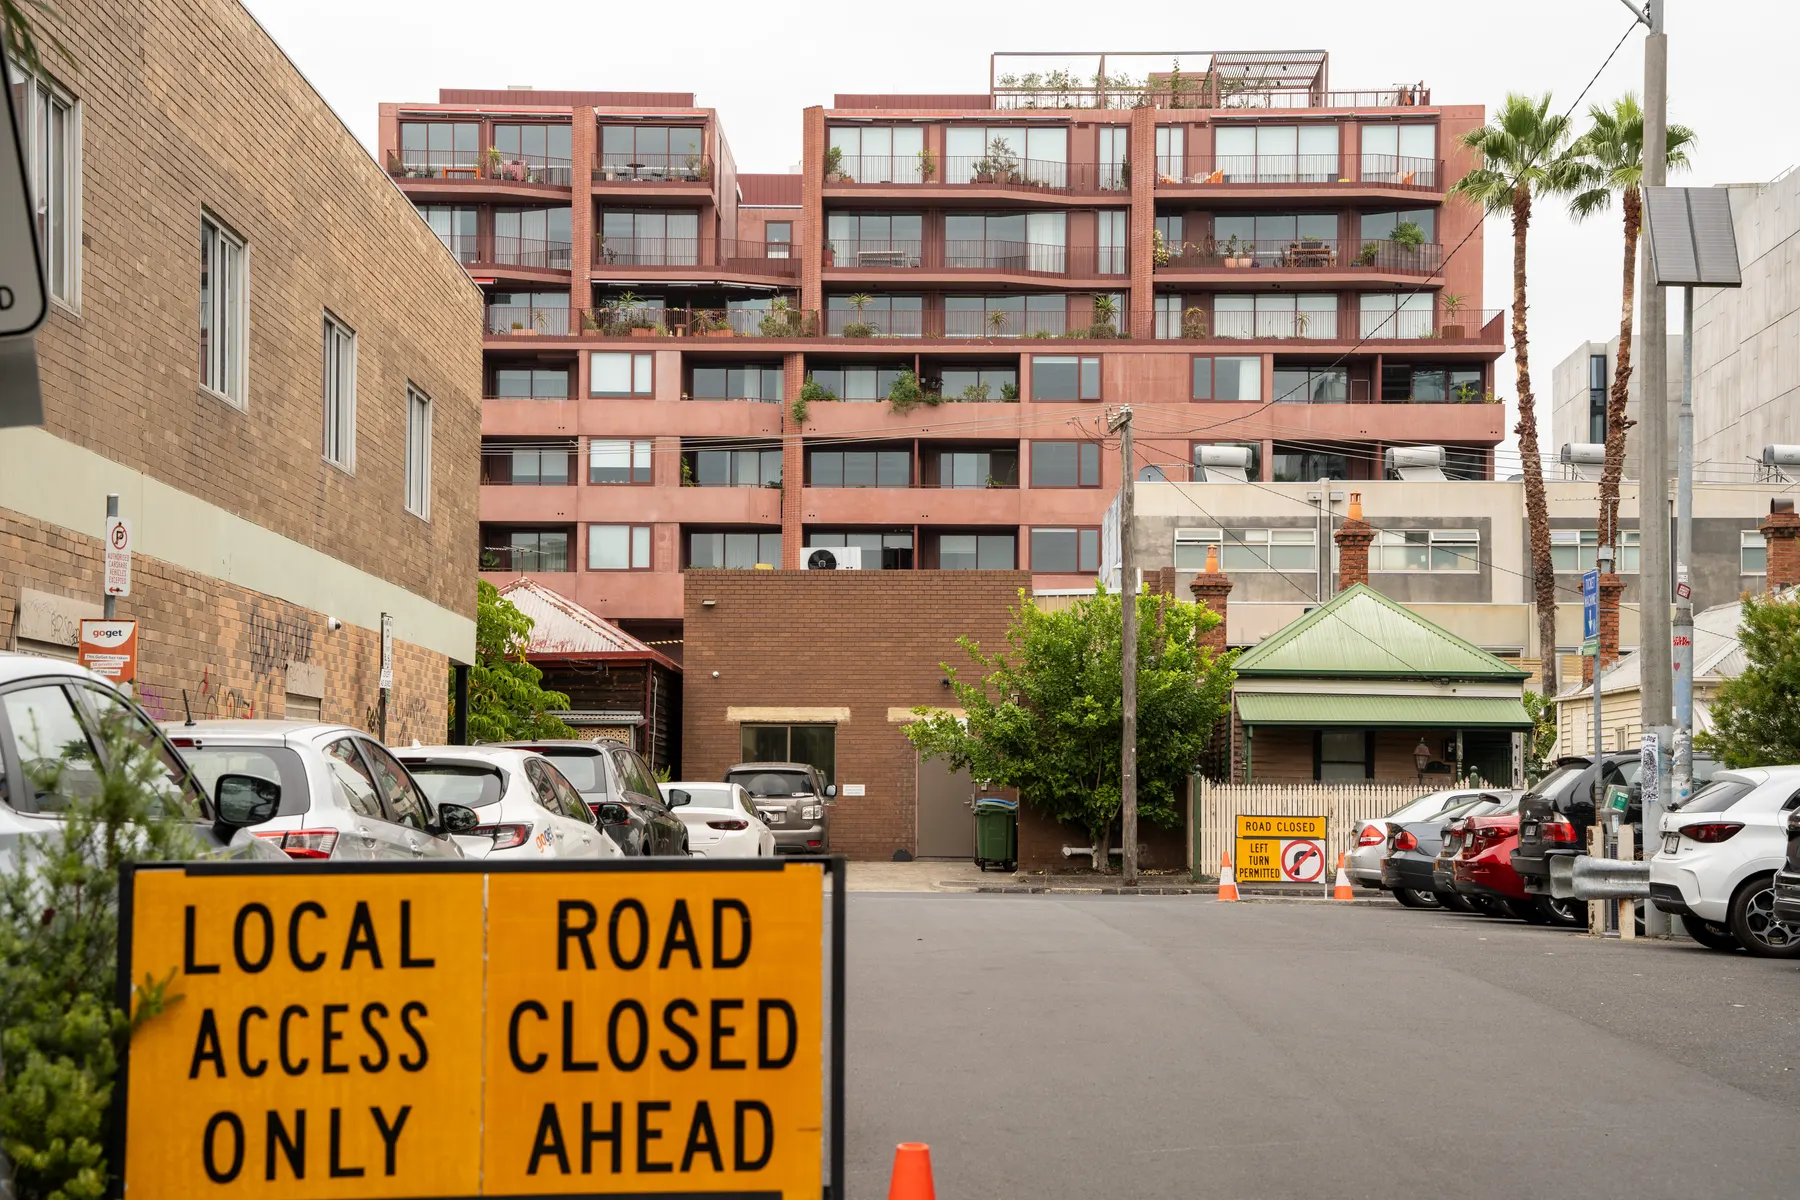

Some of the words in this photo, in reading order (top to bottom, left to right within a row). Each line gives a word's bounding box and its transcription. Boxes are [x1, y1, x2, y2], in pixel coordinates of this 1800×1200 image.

[108, 560, 128, 569] CARSHARE
[109, 568, 127, 577] VEHICLES
[108, 576, 127, 585] EXCEPTED
[92, 629, 123, 638] goget
[1245, 821, 1272, 832] ROAD
[1277, 822, 1315, 833] CLOSED
[1250, 843, 1268, 853] LEFT
[1248, 855, 1270, 866] TURN
[1239, 867, 1280, 879] PERMITTED
[184, 899, 436, 976] LOCAL
[556, 897, 753, 972] ROAD
[188, 1000, 430, 1081] ACCESS
[507, 998, 798, 1074] CLOSED
[525, 1098, 775, 1177] AHEAD
[202, 1105, 413, 1185] ONLY
